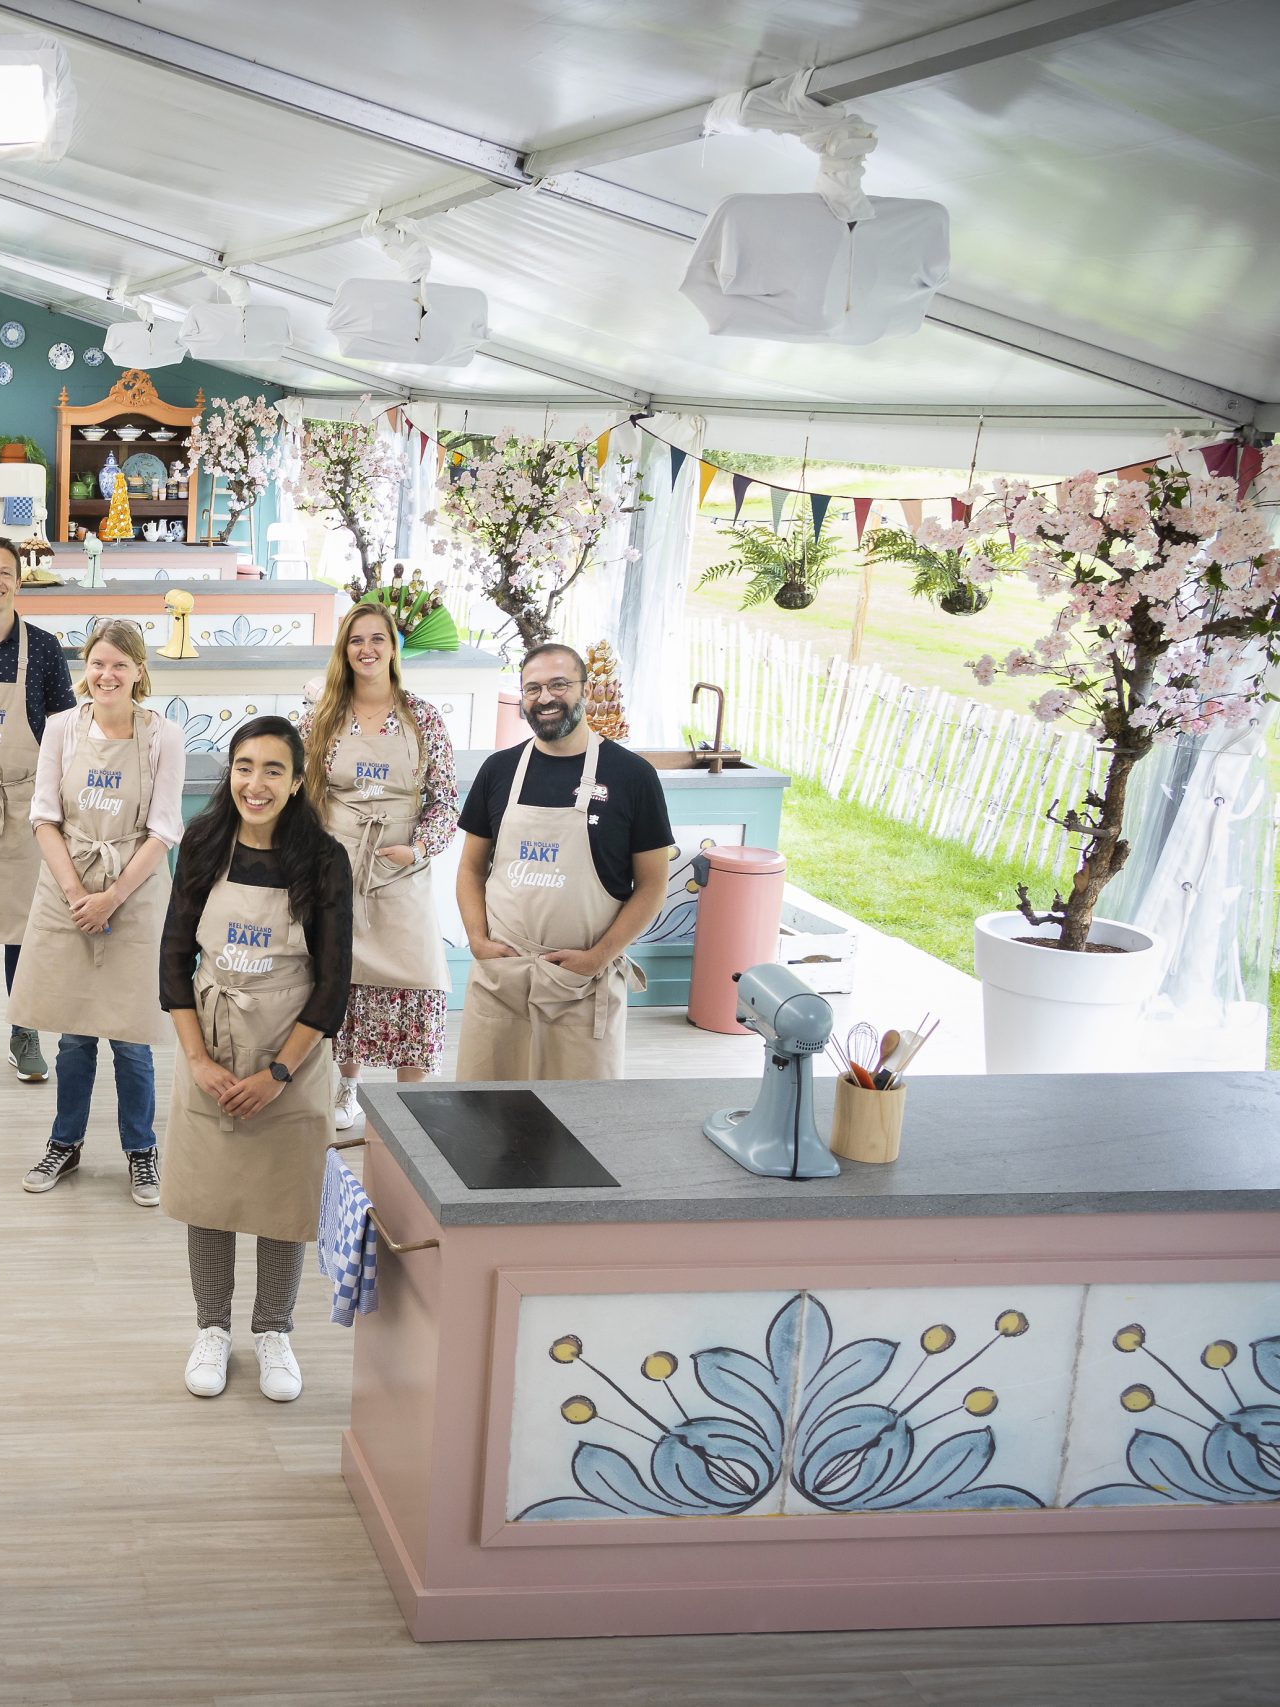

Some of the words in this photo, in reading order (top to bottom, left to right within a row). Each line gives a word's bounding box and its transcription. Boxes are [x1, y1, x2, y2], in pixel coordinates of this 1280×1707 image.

[87, 773, 122, 789] BAKT
[356, 766, 389, 780] BAKT
[78, 786, 123, 816] Mary
[519, 845, 560, 863] BAKT
[507, 859, 567, 888] Yannis
[227, 927, 272, 948] BAKT
[243, 923, 273, 934] HOLLAND
[215, 943, 274, 974] Siham
